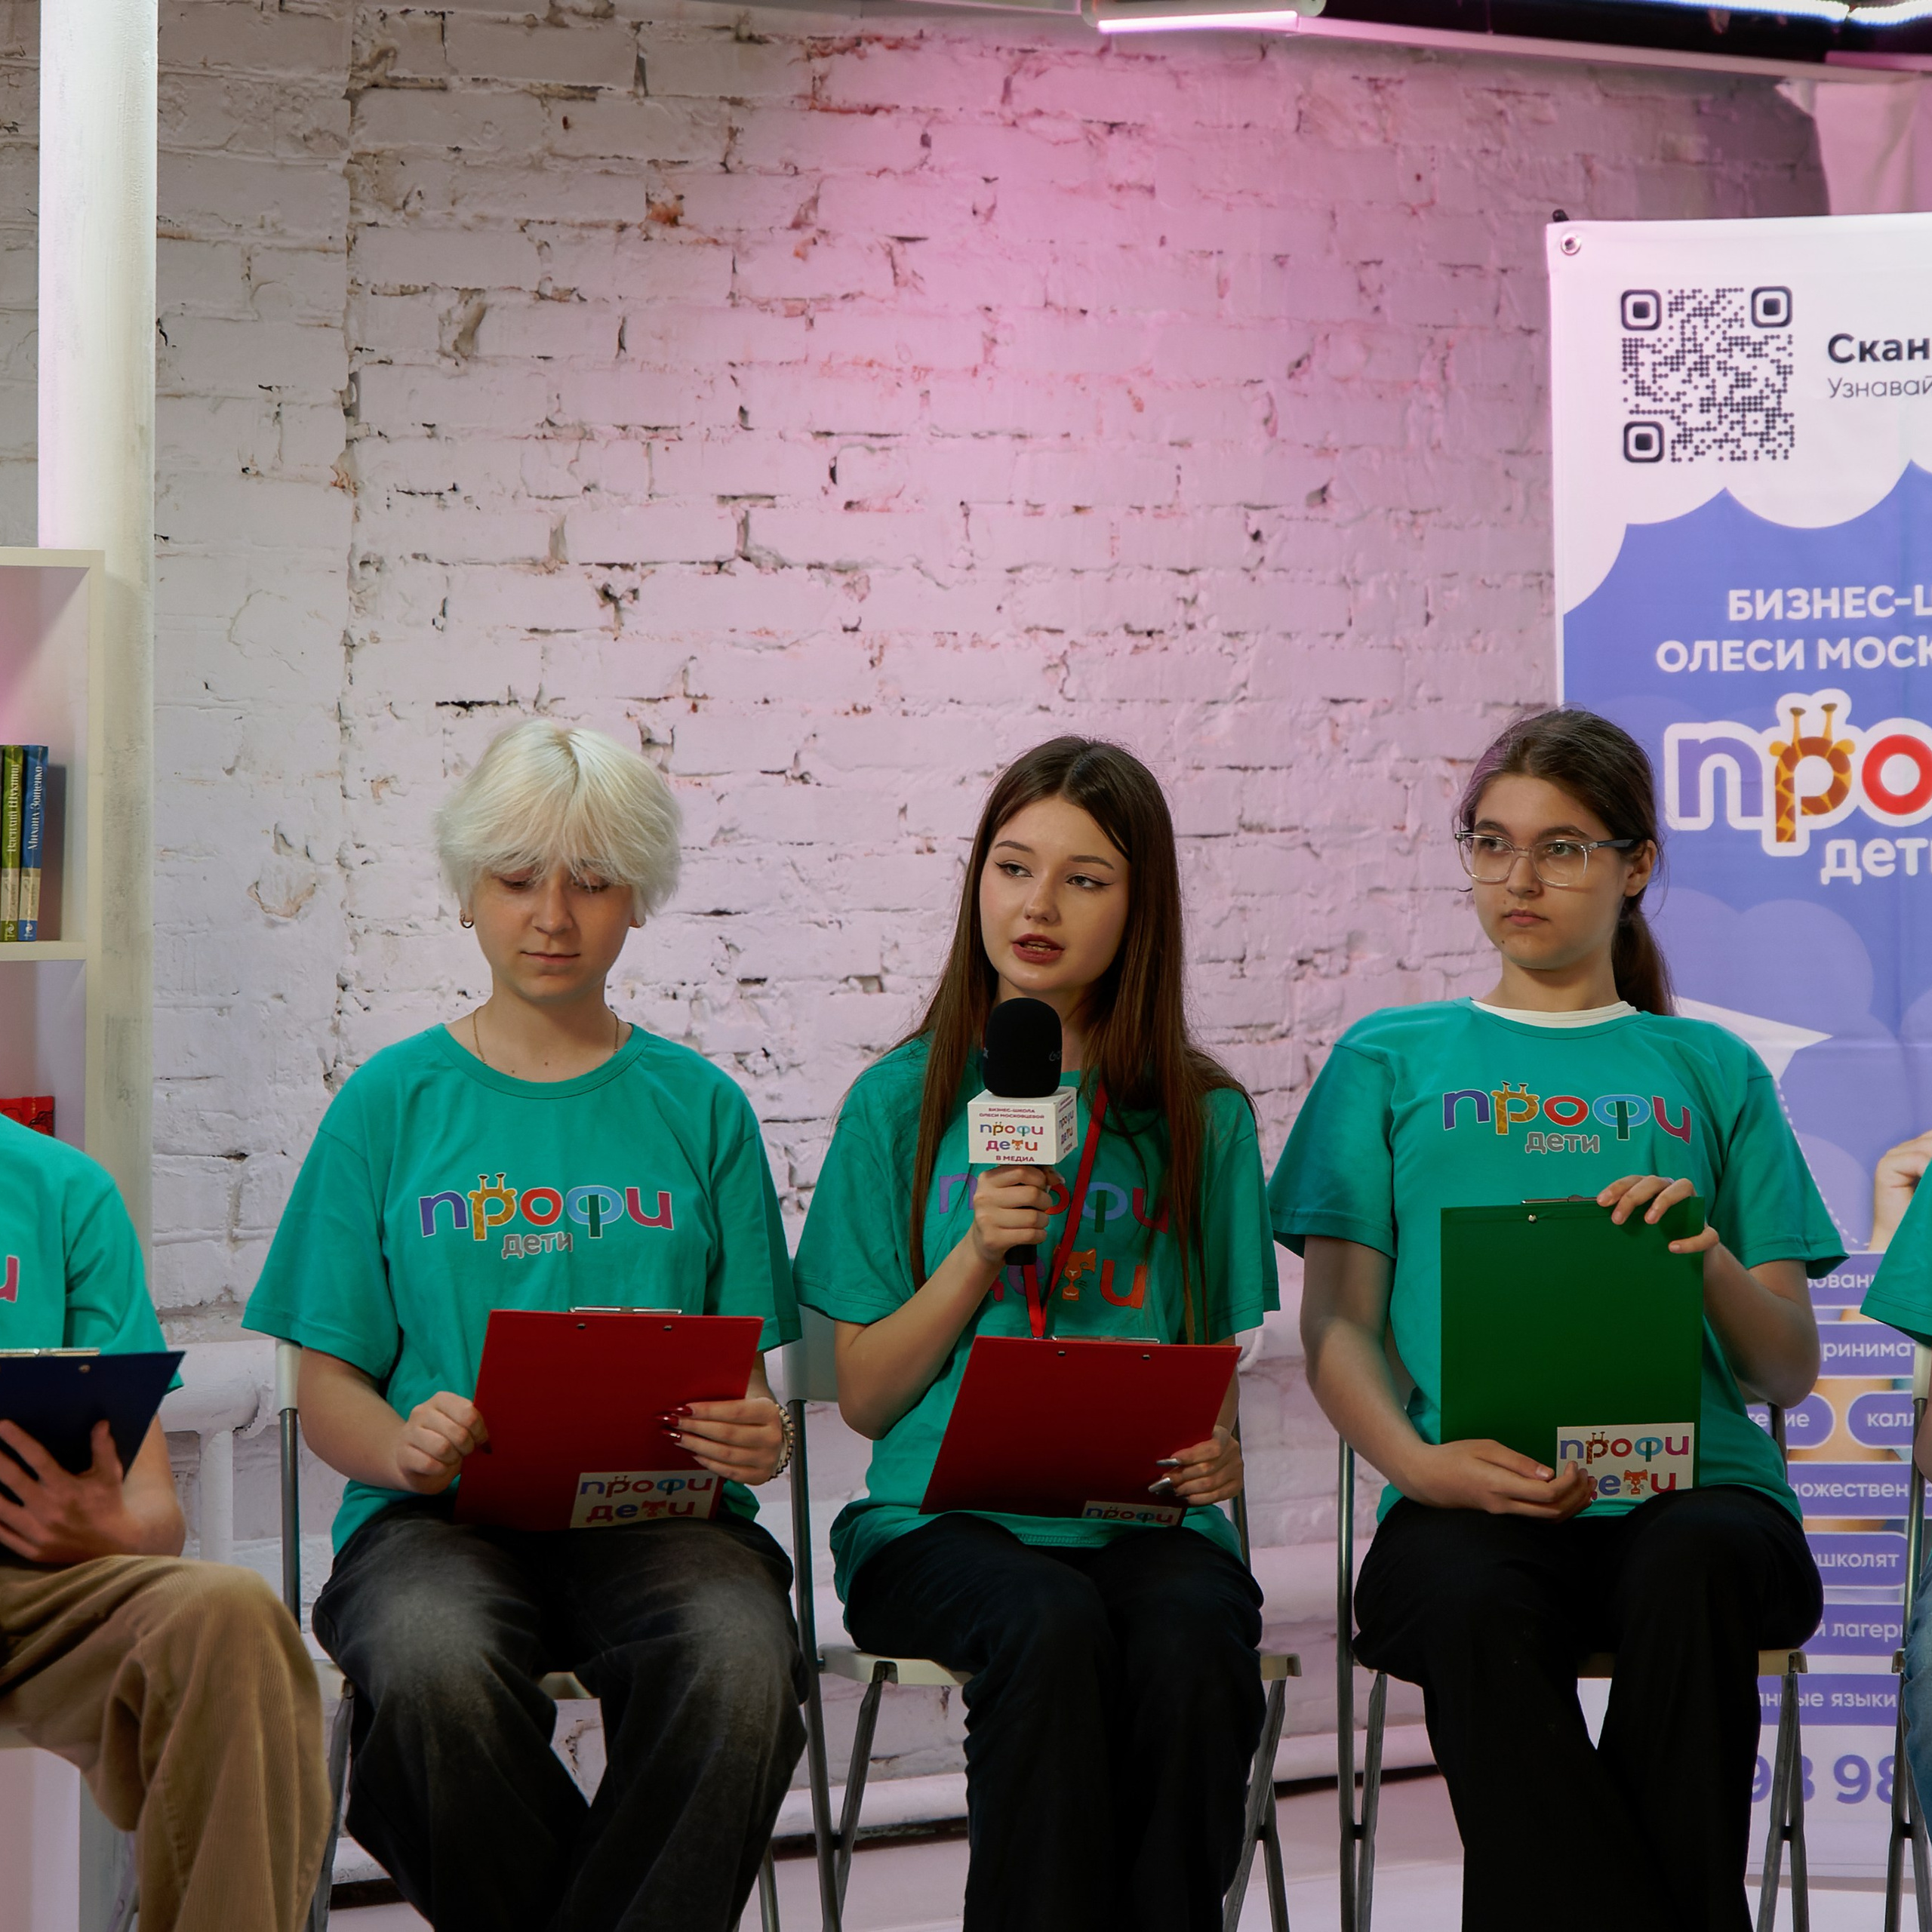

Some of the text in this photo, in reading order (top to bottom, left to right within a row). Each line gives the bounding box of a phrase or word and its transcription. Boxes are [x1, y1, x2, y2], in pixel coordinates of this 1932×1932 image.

[1827, 332, 1930, 364] Скан
[1656, 638, 1805, 673] ОЛЕСИ
[1820, 837, 1932, 885] дет
[1443, 1081, 1692, 1145] профи
[980, 1121, 1044, 1137] профи
[986, 1139, 1038, 1152] дети
[1524, 1131, 1601, 1155] дети
[418, 1172, 675, 1241] профи
[501, 1230, 574, 1260] дети
[989, 1243, 1148, 1309] ети
[1823, 1342, 1916, 1362] ринима
[1559, 1431, 1690, 1465] профи
[580, 1475, 713, 1498] профи
[1587, 1469, 1677, 1501] ети
[586, 1500, 696, 1524] дети
[1813, 1552, 1900, 1568] школят
[1832, 1623, 1903, 1643] лагер
[1831, 1693, 1897, 1708] языки
